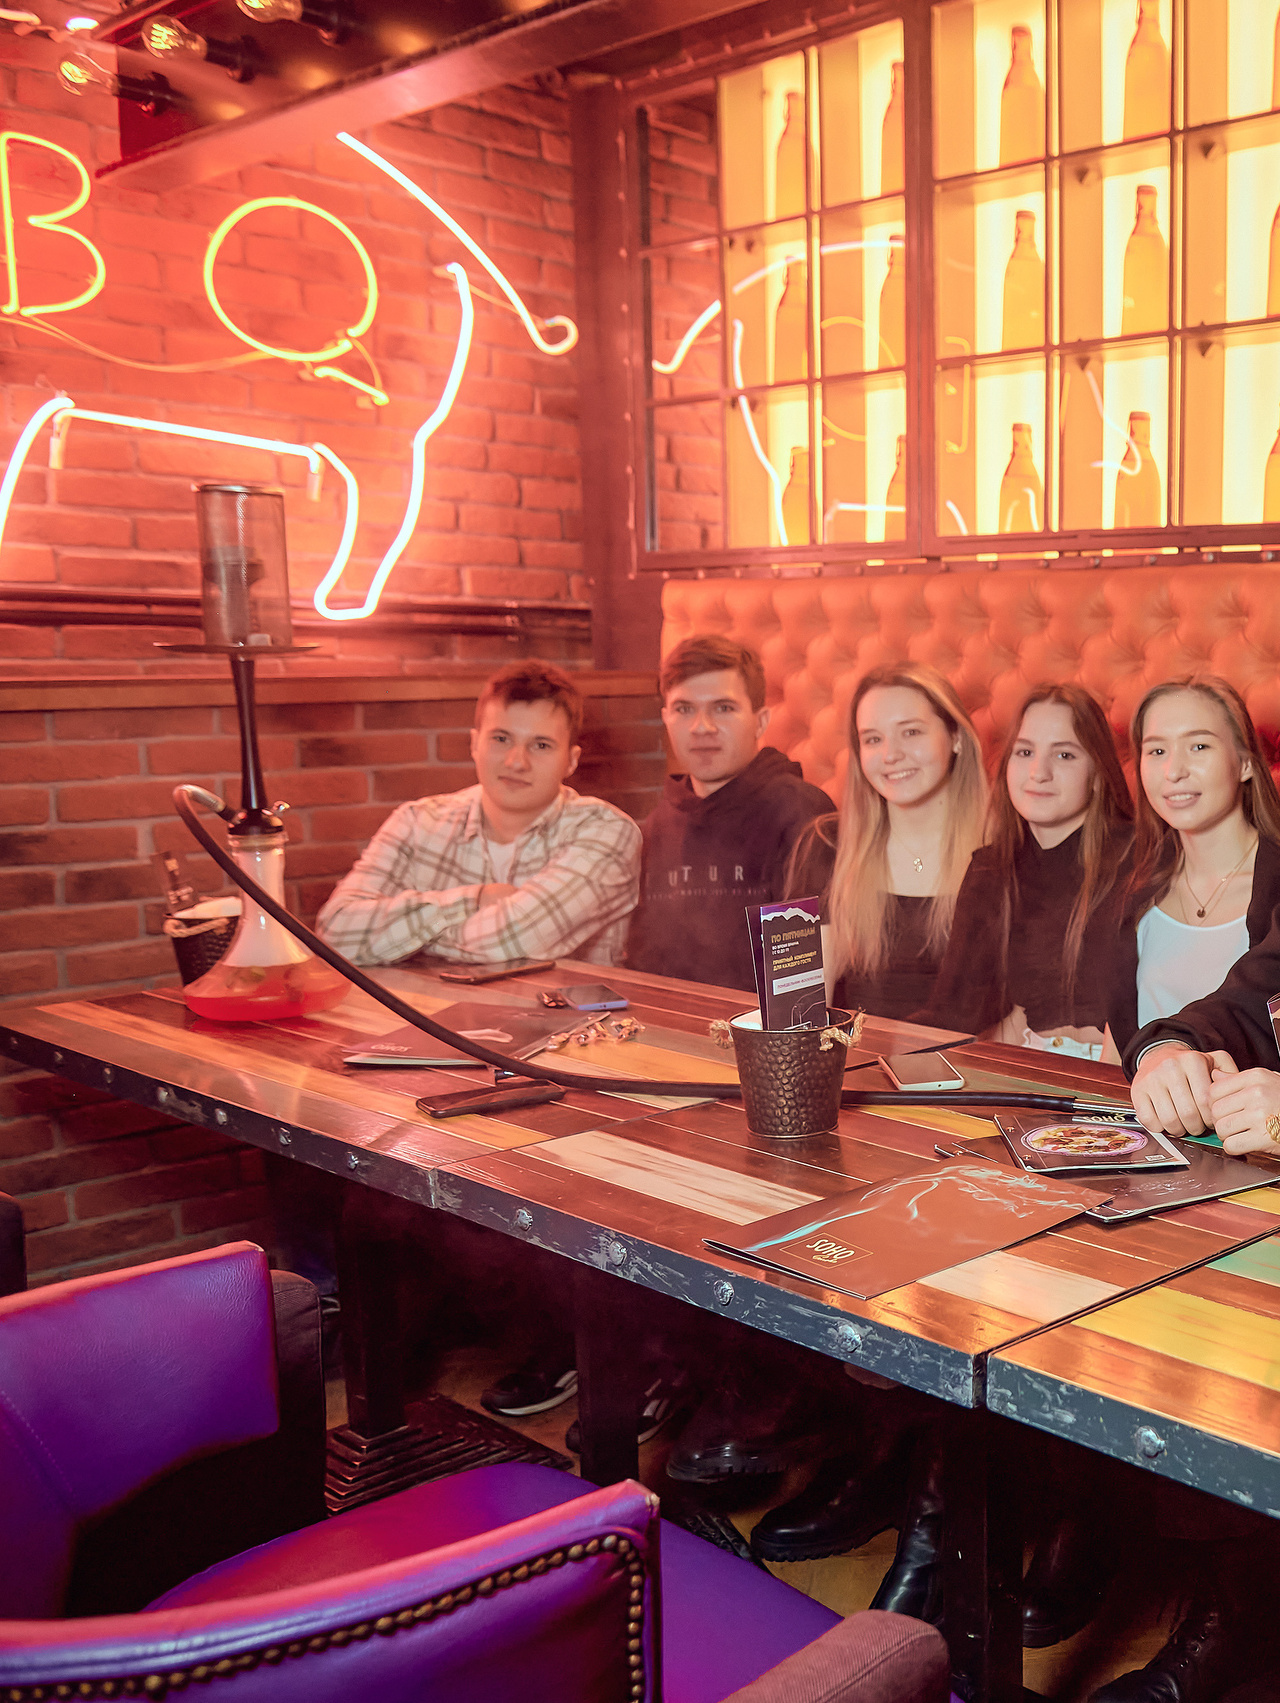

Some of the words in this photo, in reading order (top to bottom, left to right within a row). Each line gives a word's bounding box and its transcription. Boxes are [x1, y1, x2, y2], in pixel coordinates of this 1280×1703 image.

[771, 934, 782, 943] ПО
[782, 926, 816, 941] ПЯТНИЦАМ
[1082, 1114, 1126, 1122] SOHO
[806, 1239, 855, 1259] SOHO
